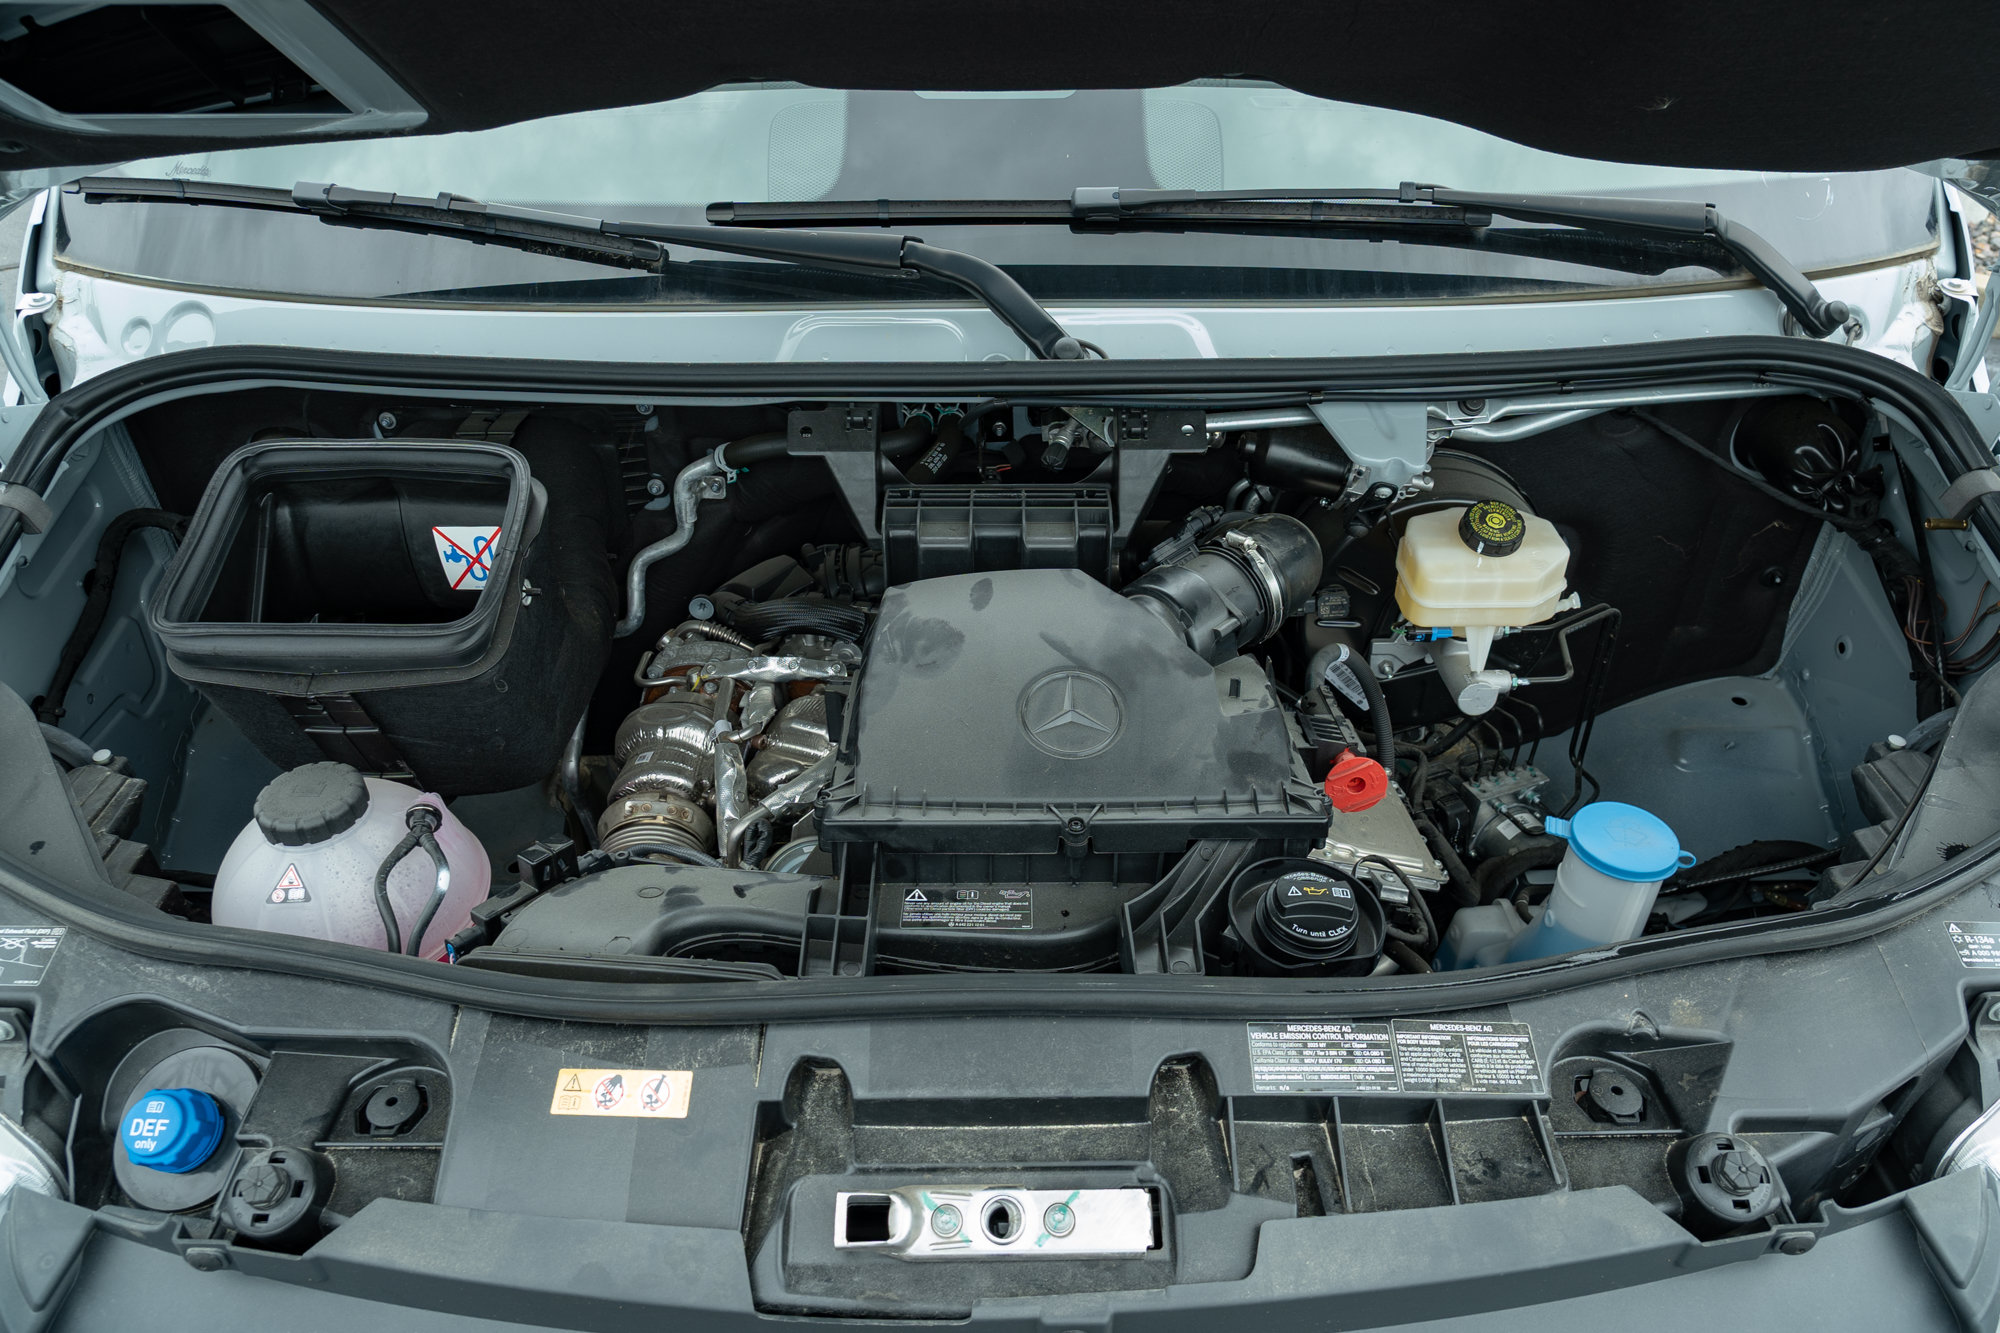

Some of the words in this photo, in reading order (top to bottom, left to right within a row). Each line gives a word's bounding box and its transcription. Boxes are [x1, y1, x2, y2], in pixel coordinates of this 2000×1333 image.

[1291, 924, 1307, 934] Turn
[1328, 926, 1348, 936] CLICK
[1964, 936, 1995, 944] R-134a
[1287, 1025, 1341, 1033] MERCEDES-BENZ
[1430, 1024, 1482, 1032] MERCEDES-BENZ
[129, 1118, 169, 1137] DEF
[134, 1138, 157, 1152] only
